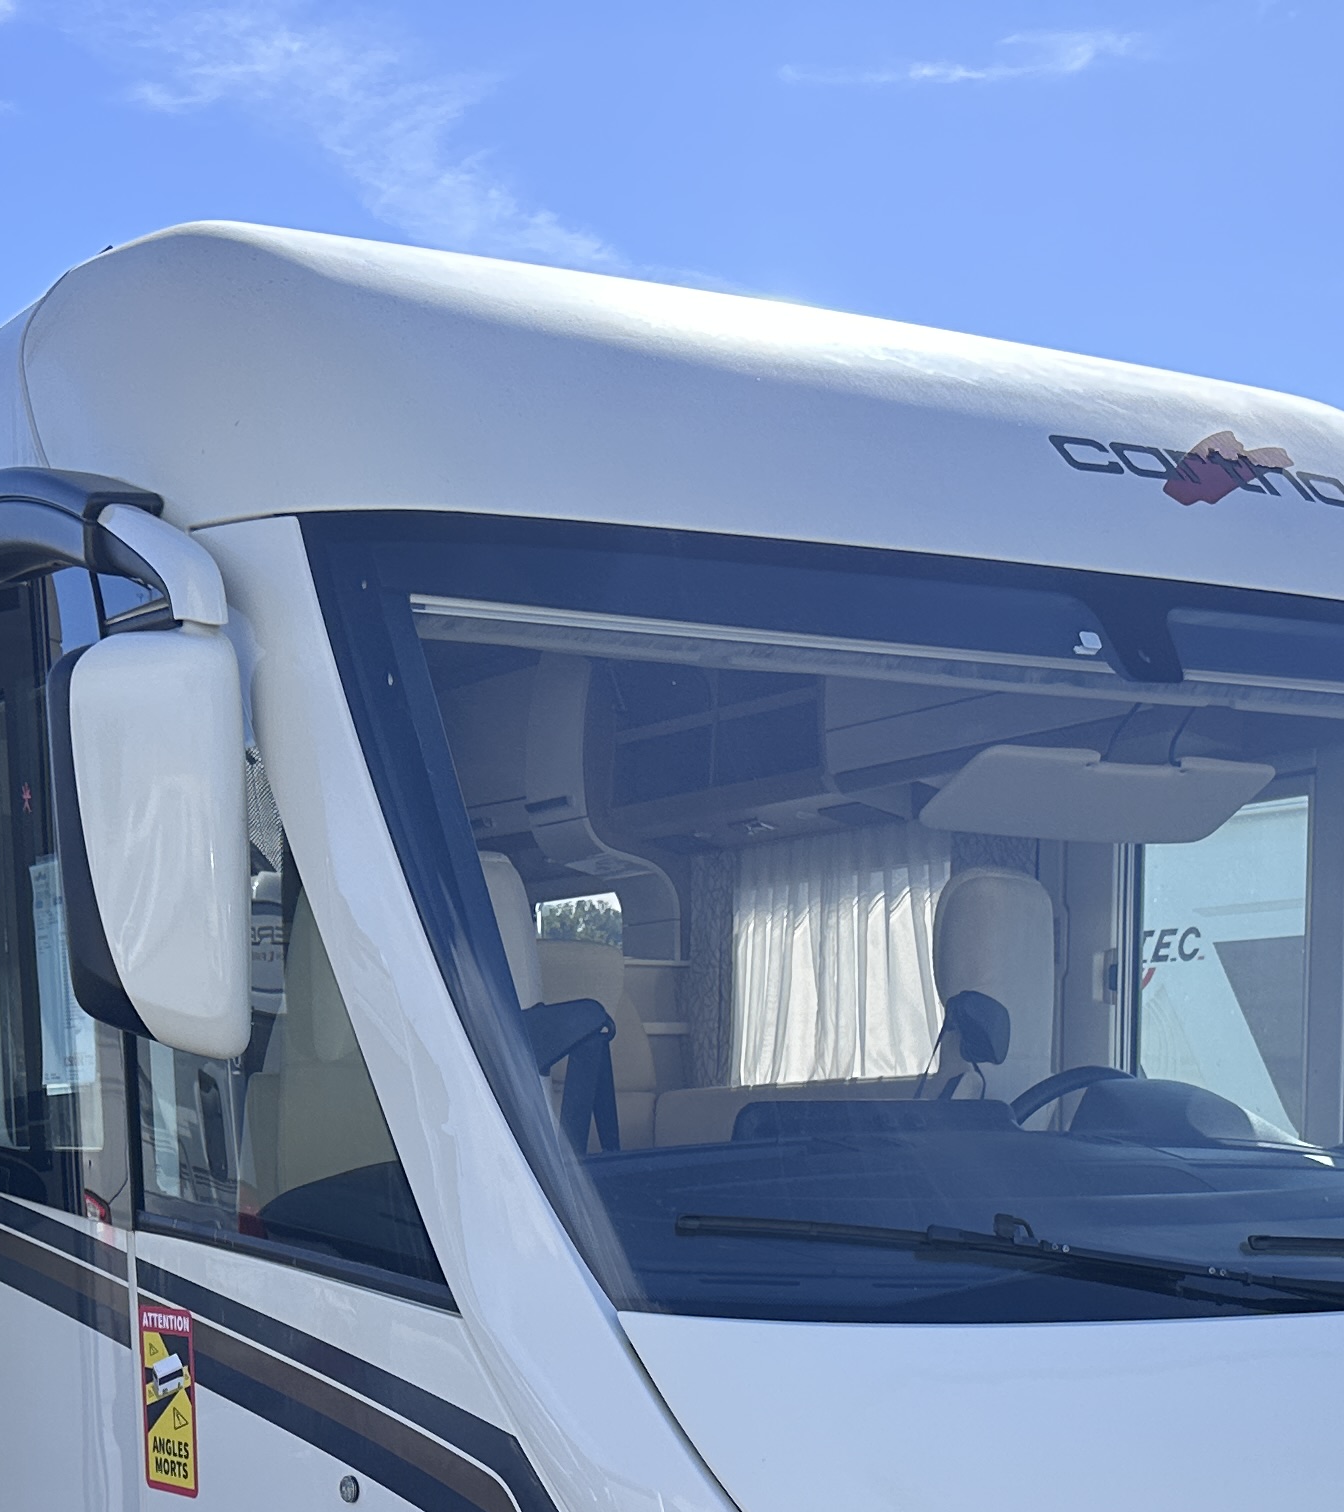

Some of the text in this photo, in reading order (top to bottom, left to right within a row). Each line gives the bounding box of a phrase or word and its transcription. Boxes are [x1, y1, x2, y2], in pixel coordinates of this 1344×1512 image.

[142, 1311, 190, 1332] ATTENTION
[152, 1435, 189, 1459] ANGLES
[155, 1456, 188, 1480] MORTS
